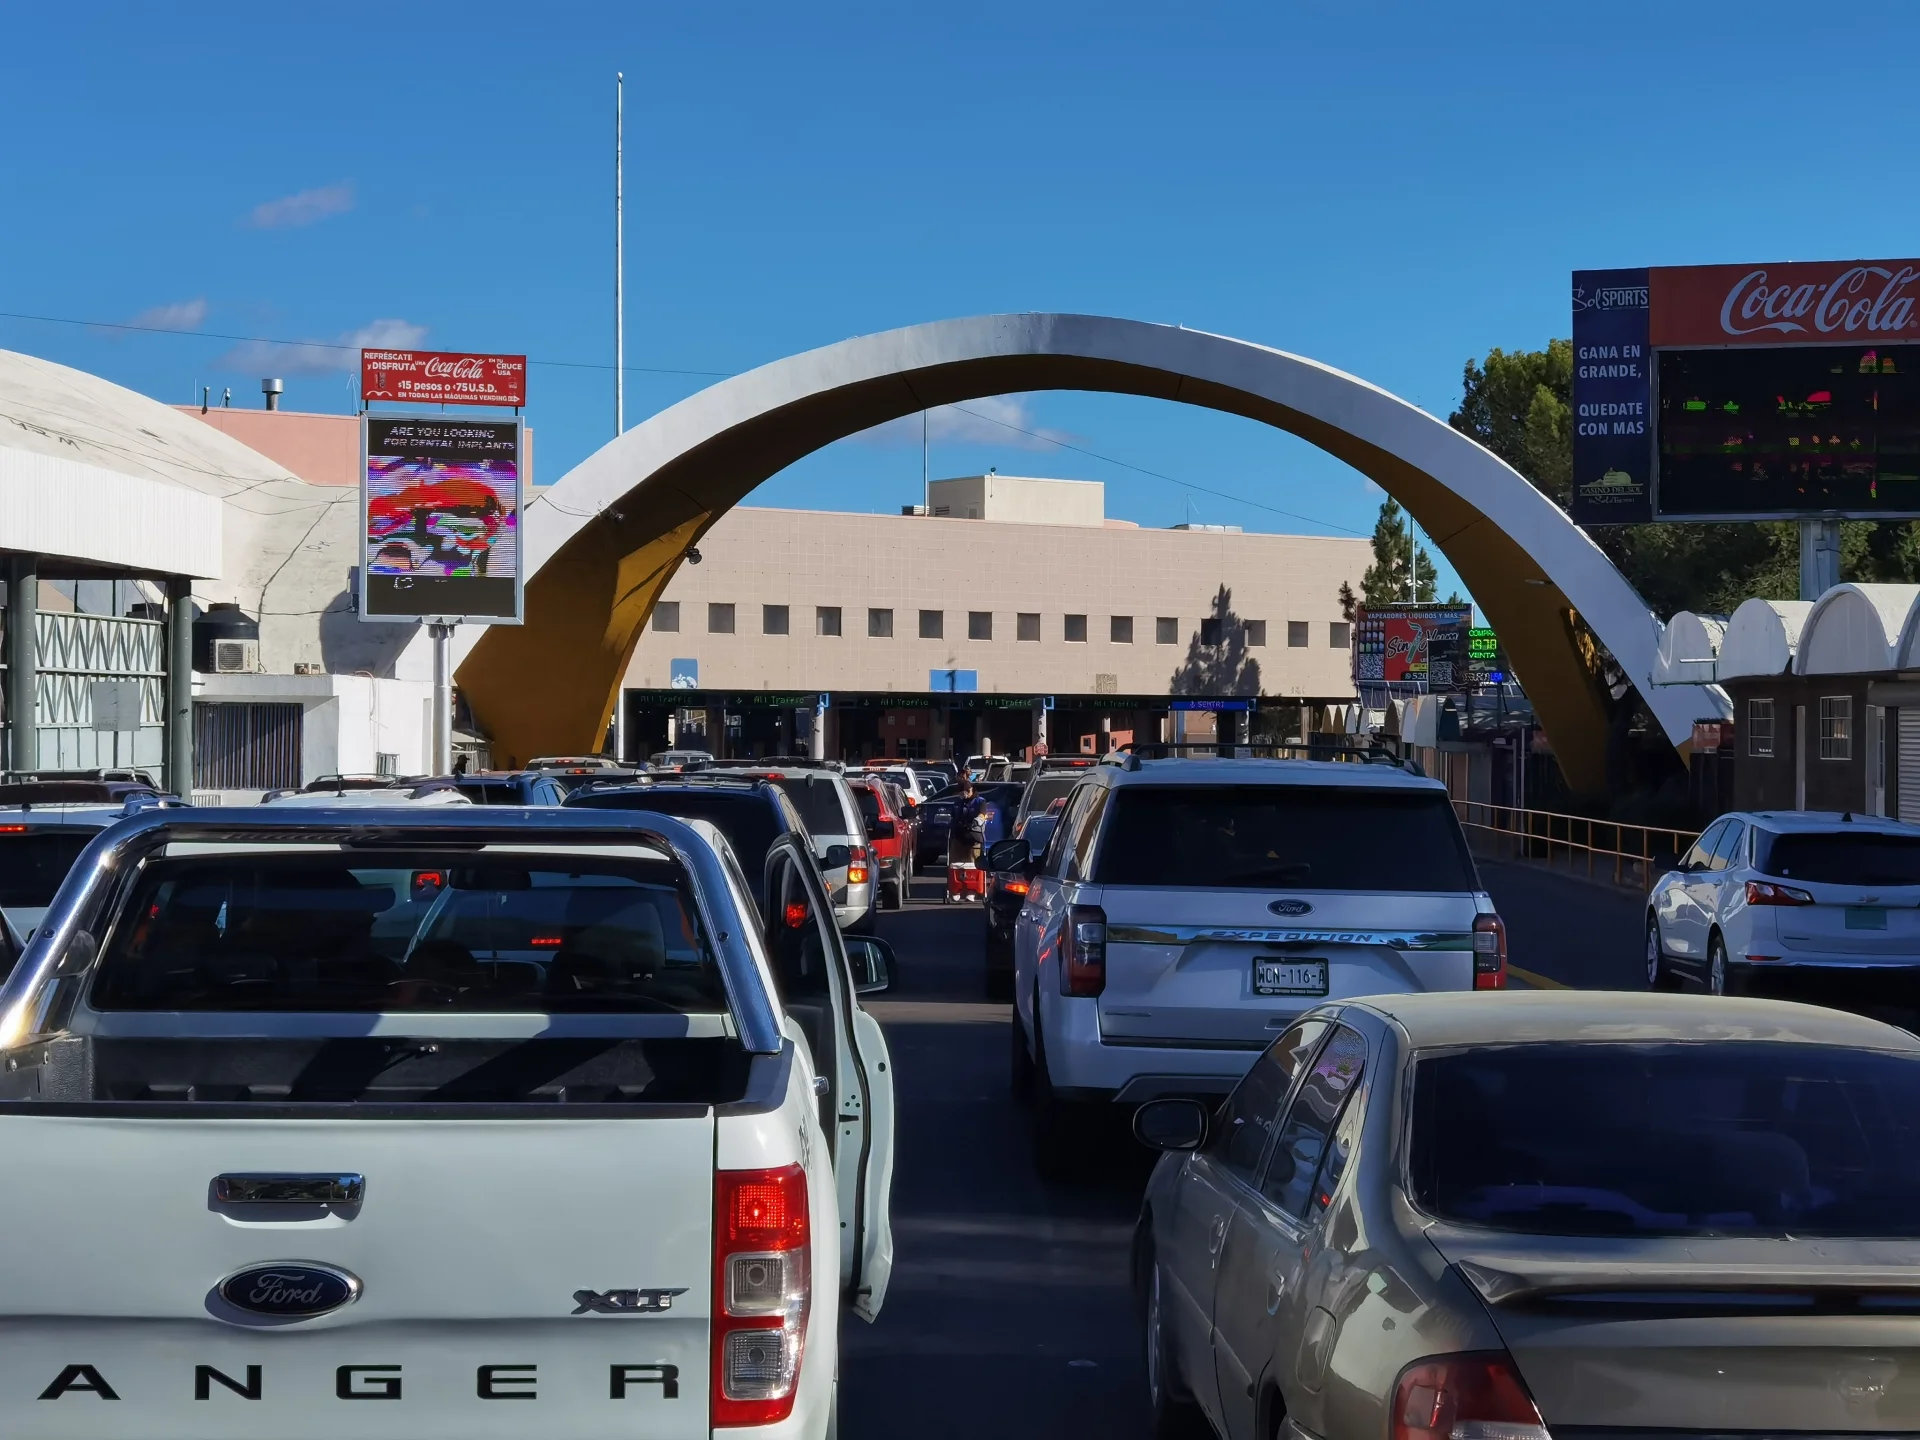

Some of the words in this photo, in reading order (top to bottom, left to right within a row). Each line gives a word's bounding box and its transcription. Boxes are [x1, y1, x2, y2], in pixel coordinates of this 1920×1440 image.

[1602, 289, 1648, 306] SPORTS
[1720, 266, 1920, 336] Coca-Cola
[1579, 346, 1619, 360] GANA
[1622, 344, 1641, 358] EN
[372, 361, 416, 371] DISFRUTA
[424, 356, 487, 379] Coca-Cola
[496, 363, 523, 371] CRUCE
[1579, 363, 1642, 379] GRANDE,
[398, 380, 412, 390] $15
[414, 382, 442, 392] pesos
[468, 382, 498, 393] U.S.D.
[1579, 402, 1643, 417] QUEDATE
[390, 426, 414, 436] ARE
[417, 427, 441, 437] YOU
[444, 428, 496, 438] LOOKING
[1578, 422, 1608, 436] CON
[1613, 420, 1644, 435] MAS
[384, 438, 408, 447] FOR
[410, 439, 453, 448] DENTAL
[458, 440, 515, 450] IMPLANTS
[1579, 486, 1611, 495] CASINO
[771, 696, 805, 704] Traffic
[1197, 701, 1224, 709] SENTRI
[1278, 902, 1304, 912] Ford
[1211, 931, 1373, 942] EXPEDITION
[249, 1273, 324, 1304] Ford
[571, 1287, 691, 1315] XLT
